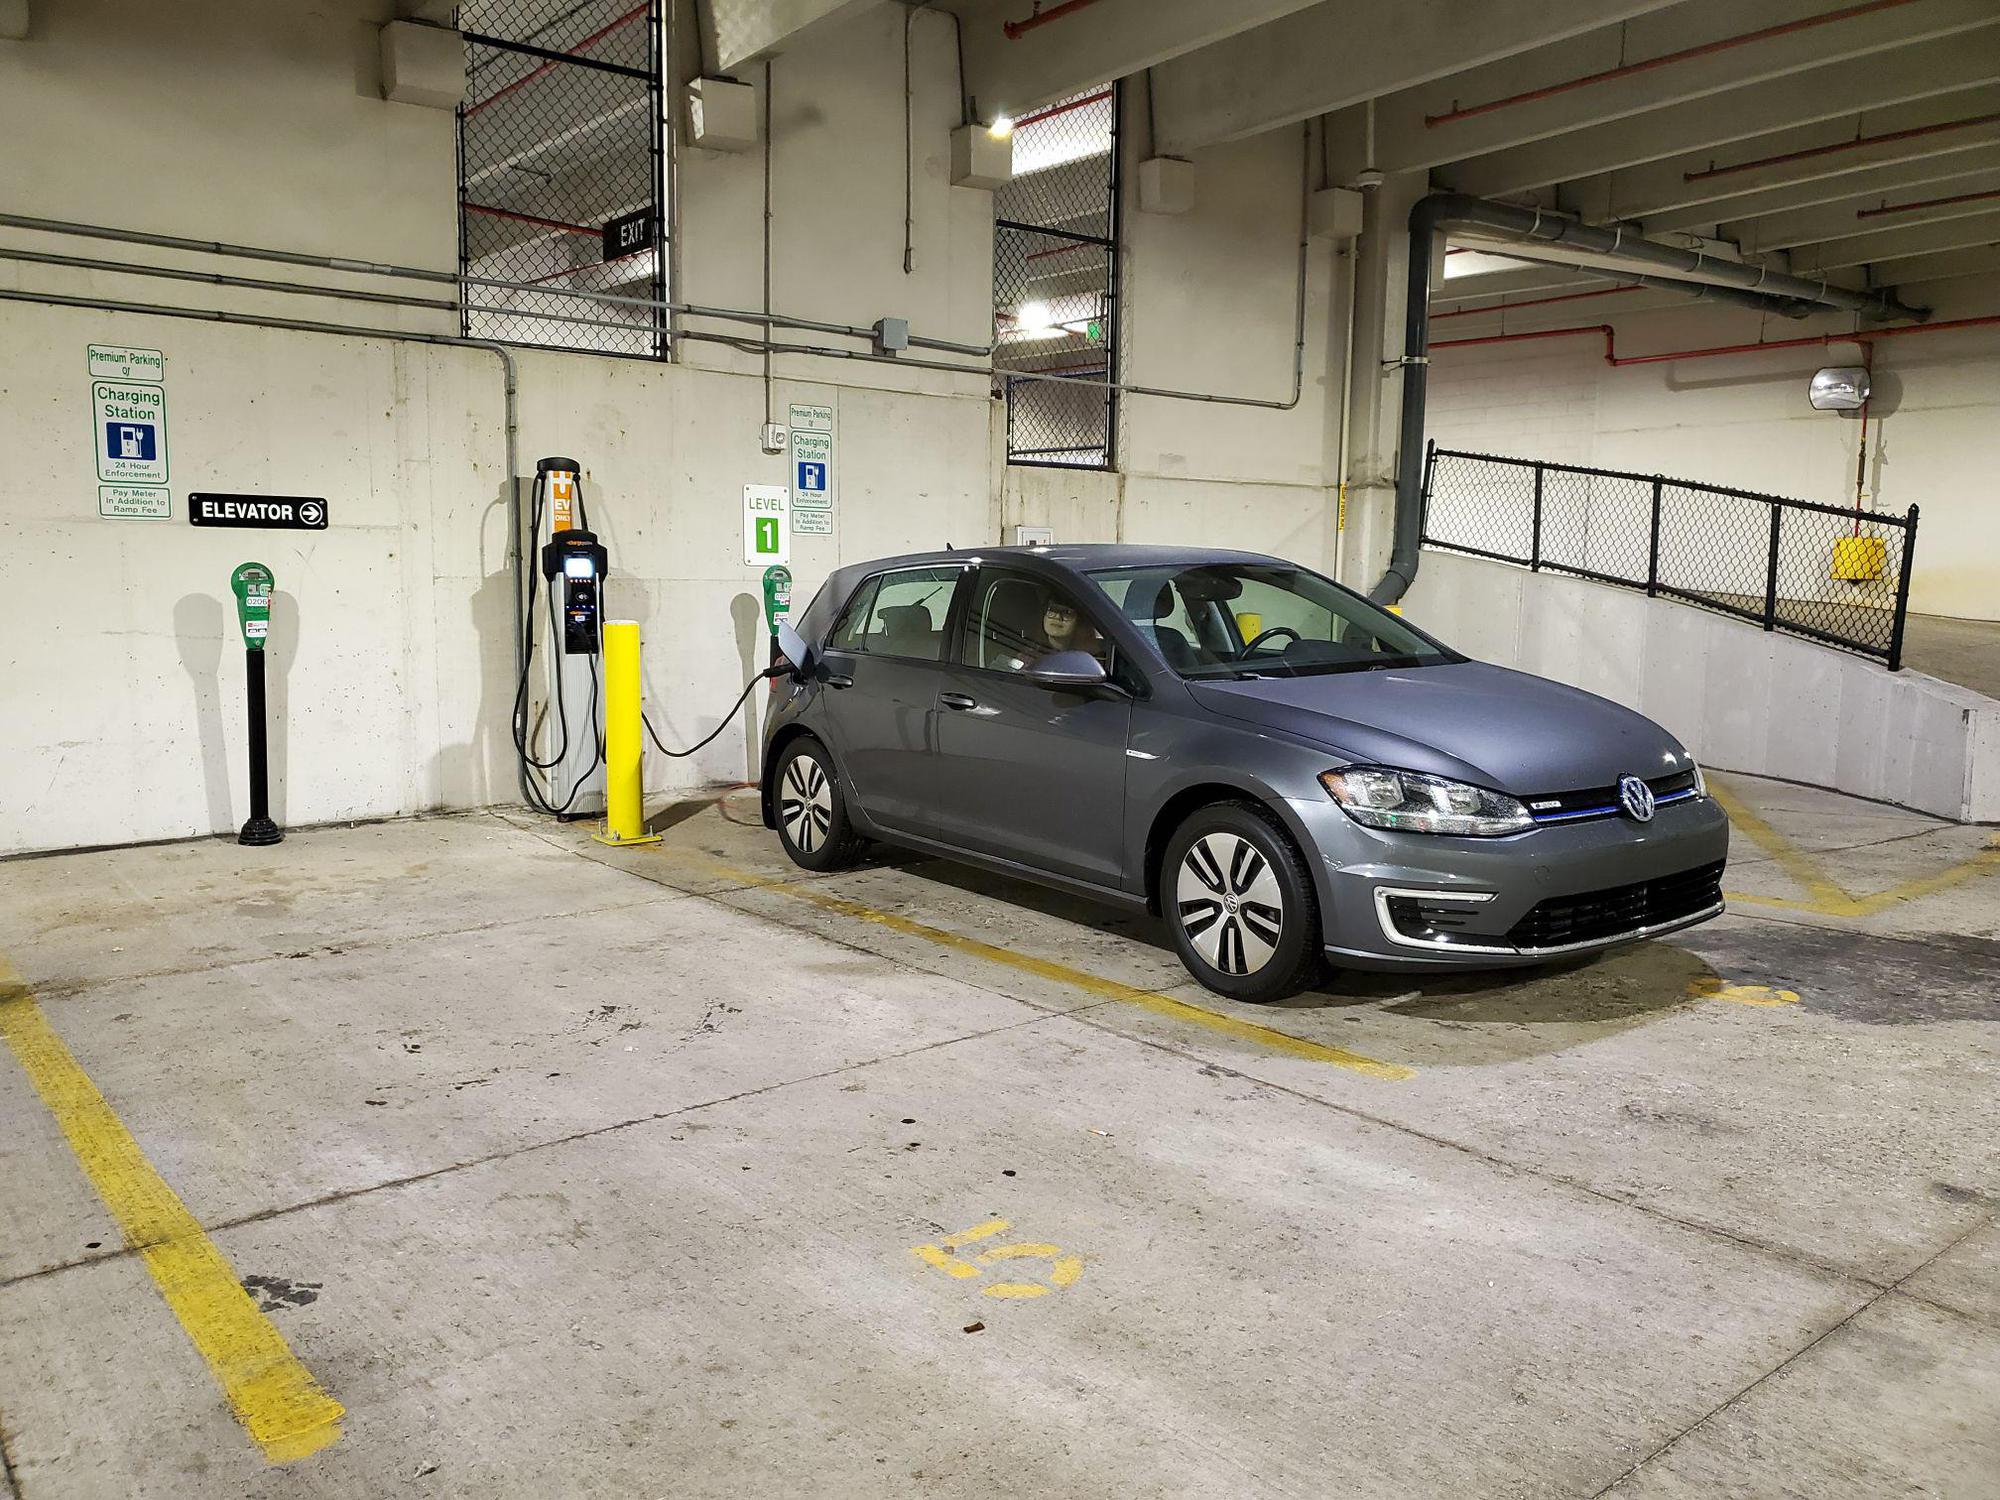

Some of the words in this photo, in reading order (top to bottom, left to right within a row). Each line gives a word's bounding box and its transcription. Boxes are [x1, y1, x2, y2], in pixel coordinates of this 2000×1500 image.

[620, 217, 645, 247] EXIT
[90, 350, 127, 364] Premium
[129, 353, 161, 369] Parking
[97, 386, 160, 406] Charging
[104, 404, 155, 420] Station
[793, 434, 830, 449] Charging
[797, 448, 827, 460] Station
[114, 461, 126, 469] 24
[129, 462, 150, 470] Hour
[105, 469, 161, 479] Enforcement
[112, 488, 128, 498] Pay
[131, 489, 157, 498] Meter
[117, 498, 153, 506] Addition
[554, 498, 571, 511] EV
[749, 497, 785, 511] LEVEL
[113, 505, 138, 514] Ramp
[201, 501, 294, 521] ELEVATOR
[762, 521, 773, 550] 1
